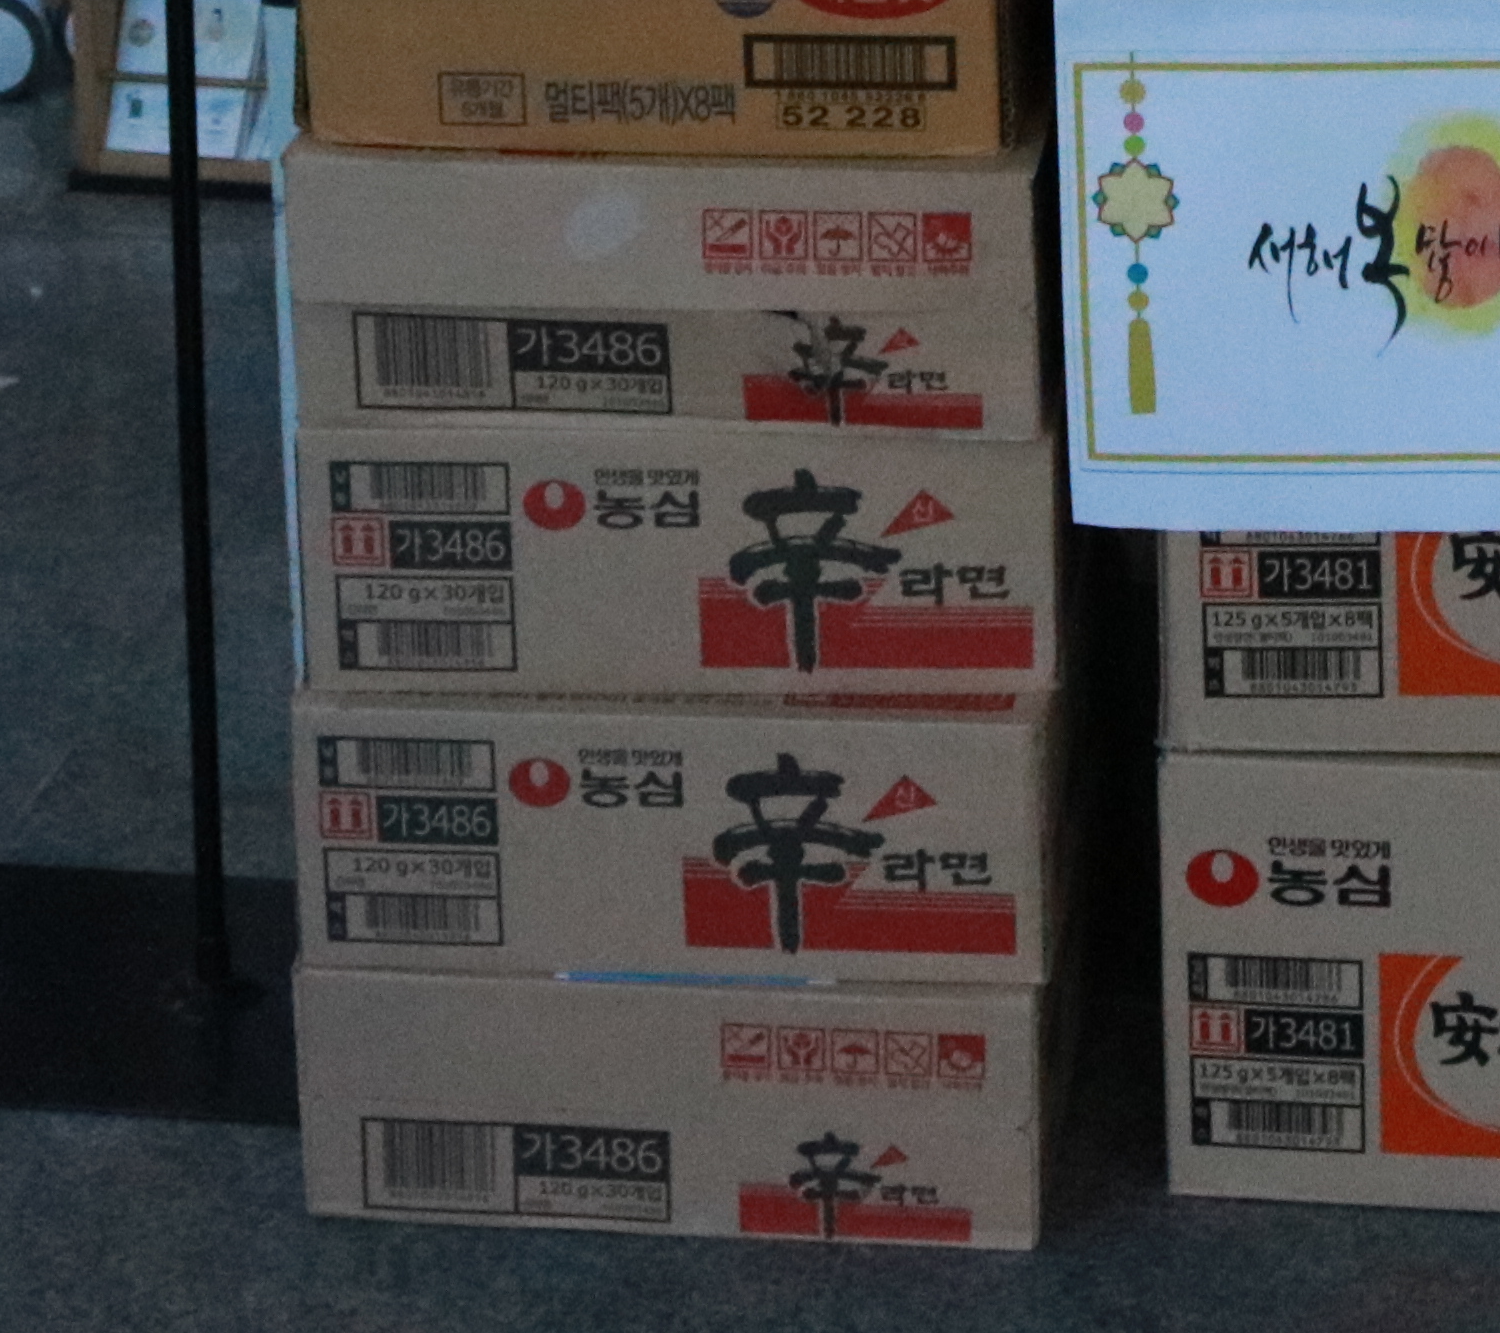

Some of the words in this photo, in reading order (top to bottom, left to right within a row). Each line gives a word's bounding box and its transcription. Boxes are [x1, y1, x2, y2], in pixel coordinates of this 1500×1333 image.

[782, 106, 829, 129] 52
[845, 105, 922, 129] 228
[516, 327, 663, 369] 가3486
[536, 375, 574, 394] 120
[887, 369, 949, 394] 라면
[594, 489, 702, 531] 농심
[911, 500, 938, 523] 신
[398, 533, 507, 565] 가3486
[729, 467, 903, 674] 辛
[897, 562, 1012, 606] 라면
[1263, 556, 1374, 594] 가3481
[364, 581, 405, 603] 120
[1212, 609, 1247, 628] 125
[579, 770, 686, 810] 농심
[892, 785, 919, 807] 신
[381, 800, 493, 841] 가3486
[351, 855, 396, 877] 120
[711, 751, 887, 955] 辛
[1267, 837, 1326, 858] 인생을
[1330, 838, 1392, 861] 맛있게
[880, 848, 993, 889] 라면
[1267, 860, 1392, 910] 농심
[1251, 1014, 1357, 1052] 가3481
[520, 1133, 663, 1173] 가3486
[537, 1180, 576, 1200] 120
[787, 1131, 881, 1241] 辛
[878, 1180, 940, 1207] 라면
